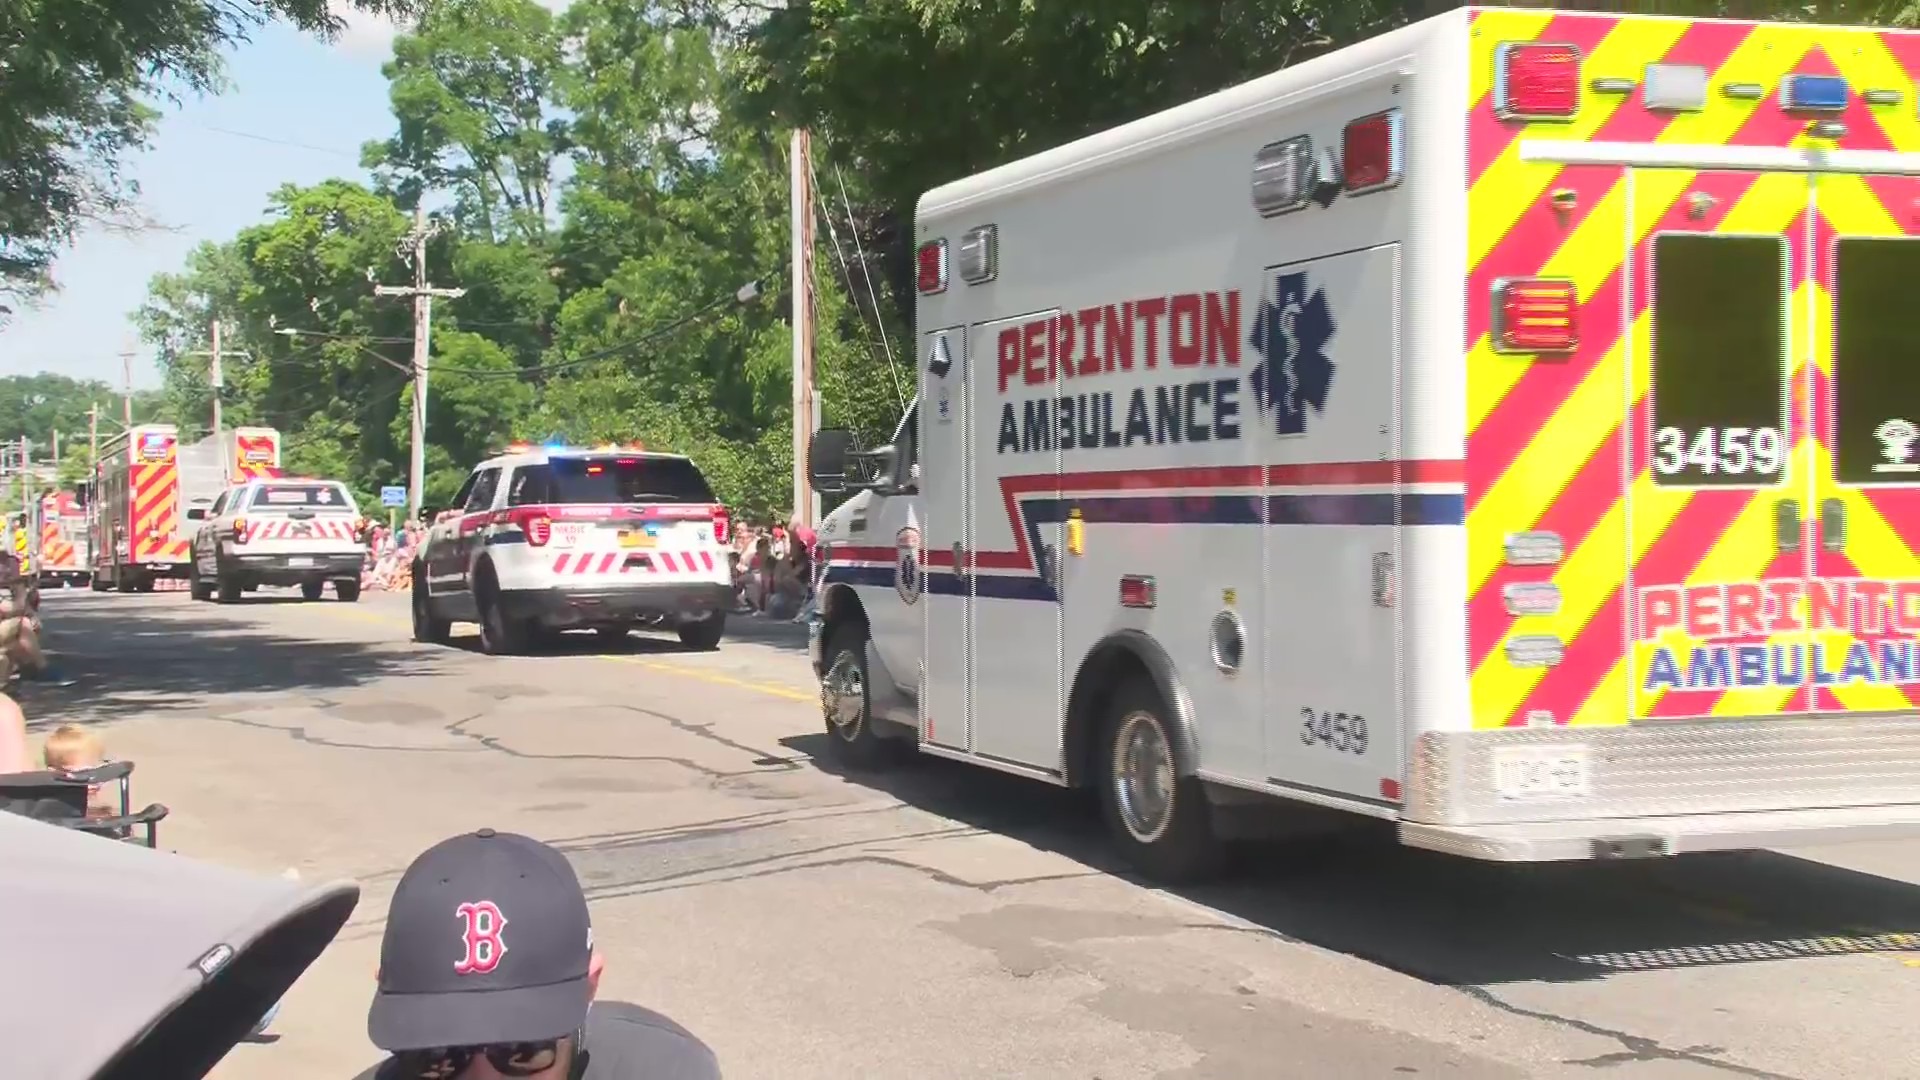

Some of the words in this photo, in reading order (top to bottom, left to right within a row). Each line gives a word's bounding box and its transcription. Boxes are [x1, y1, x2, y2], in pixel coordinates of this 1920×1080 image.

[996, 288, 1242, 395] PERINTON
[996, 377, 1242, 455] AMBULANCE
[1652, 426, 1784, 477] 3459
[1299, 706, 1369, 756] 3459
[454, 900, 509, 975] B
